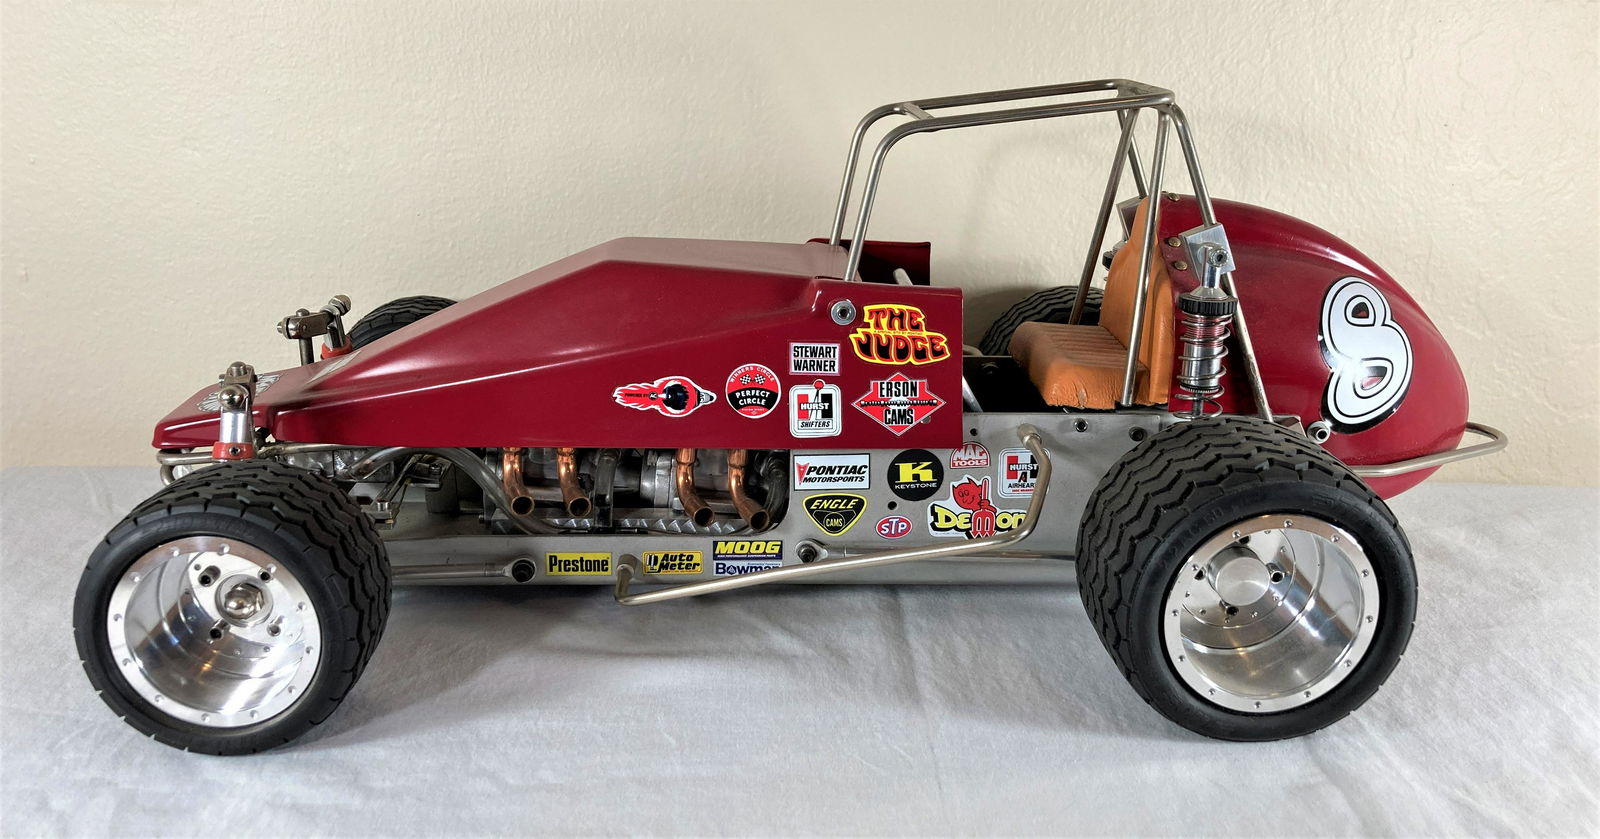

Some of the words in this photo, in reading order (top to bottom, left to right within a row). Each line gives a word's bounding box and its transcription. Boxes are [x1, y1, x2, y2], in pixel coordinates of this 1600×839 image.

[867, 307, 924, 331] THE
[793, 346, 838, 359] STEWART
[854, 331, 948, 362] JUDGE
[1320, 276, 1414, 431] 8
[793, 360, 836, 372] WARNER
[729, 366, 754, 383] WINNERS
[756, 366, 775, 382] CIRCLE
[735, 390, 770, 399] PERFECT
[880, 382, 918, 398] ERSON
[738, 398, 767, 406] CIRCLE
[800, 403, 830, 411] HURST
[884, 409, 914, 425] CAMS
[953, 459, 987, 467] TOOLS
[805, 465, 868, 476] PONTIAC
[895, 462, 937, 483] K
[810, 499, 859, 509] ENGLE
[825, 518, 843, 527] CAMS
[880, 518, 907, 534] STP
[715, 541, 782, 554] MOOG
[549, 555, 609, 572] Prestone
[660, 553, 695, 562] Auto
[658, 562, 700, 571] Meter
